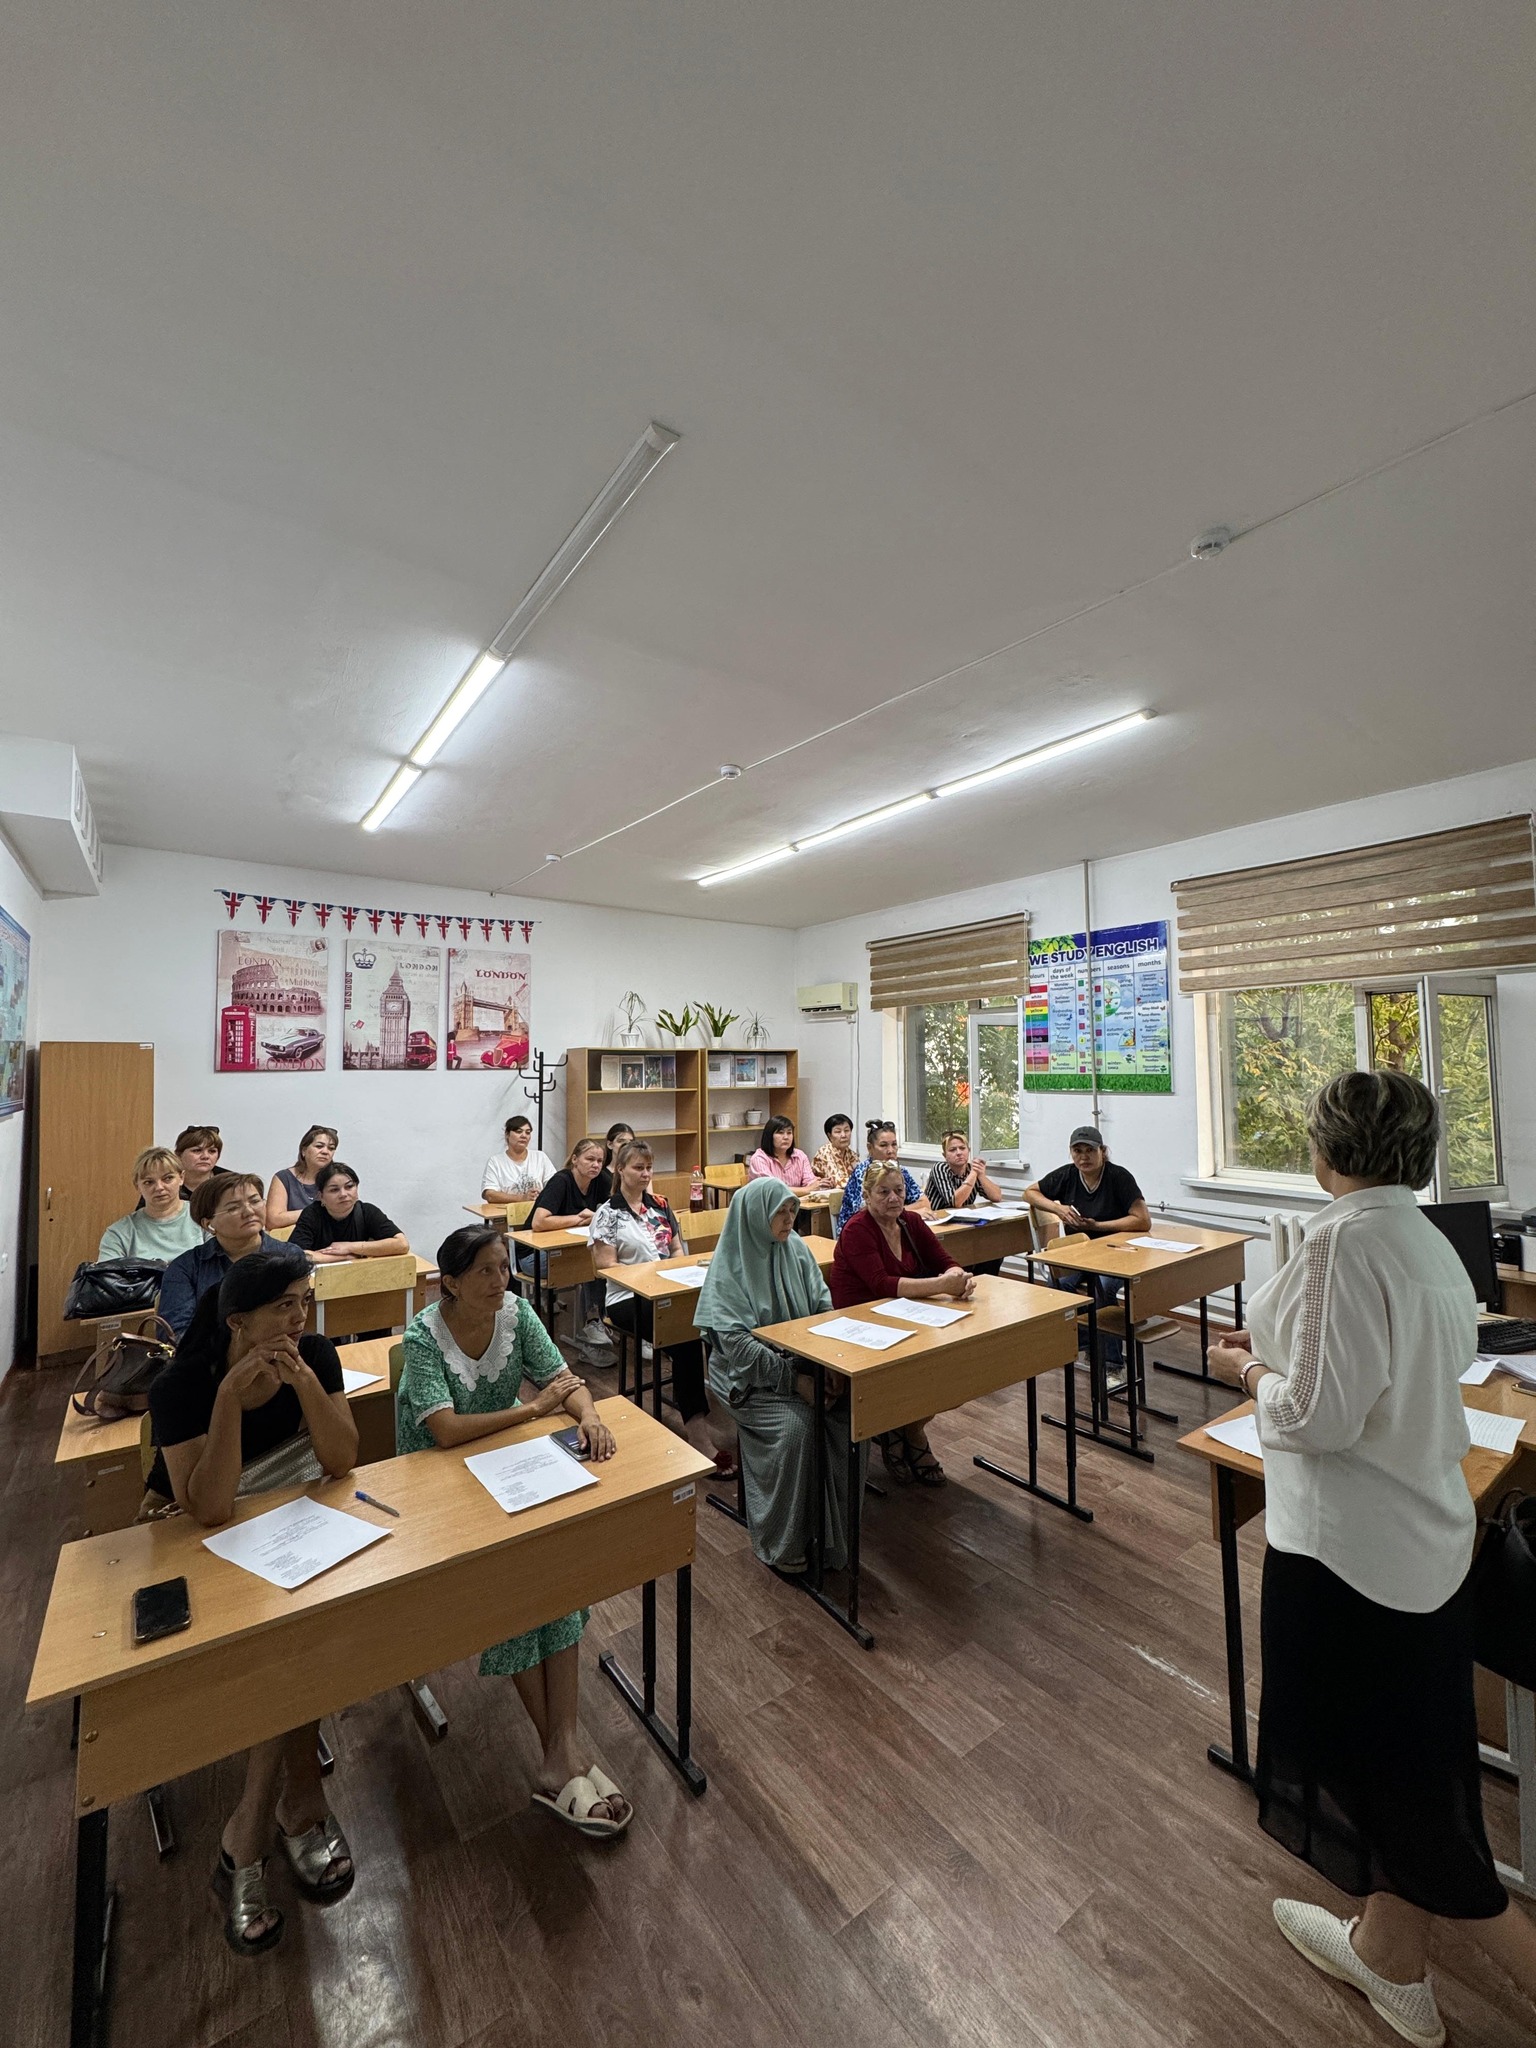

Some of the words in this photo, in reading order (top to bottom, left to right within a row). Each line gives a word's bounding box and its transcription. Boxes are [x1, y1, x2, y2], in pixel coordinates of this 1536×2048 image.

[1030, 954, 1049, 965] WE
[1050, 947, 1095, 963] STUDY
[1096, 938, 1158, 958] ENGLISH
[400, 962, 438, 971] LONDON
[1107, 963, 1130, 971] seasons
[1137, 959, 1162, 968] months
[475, 969, 528, 981] LONDON
